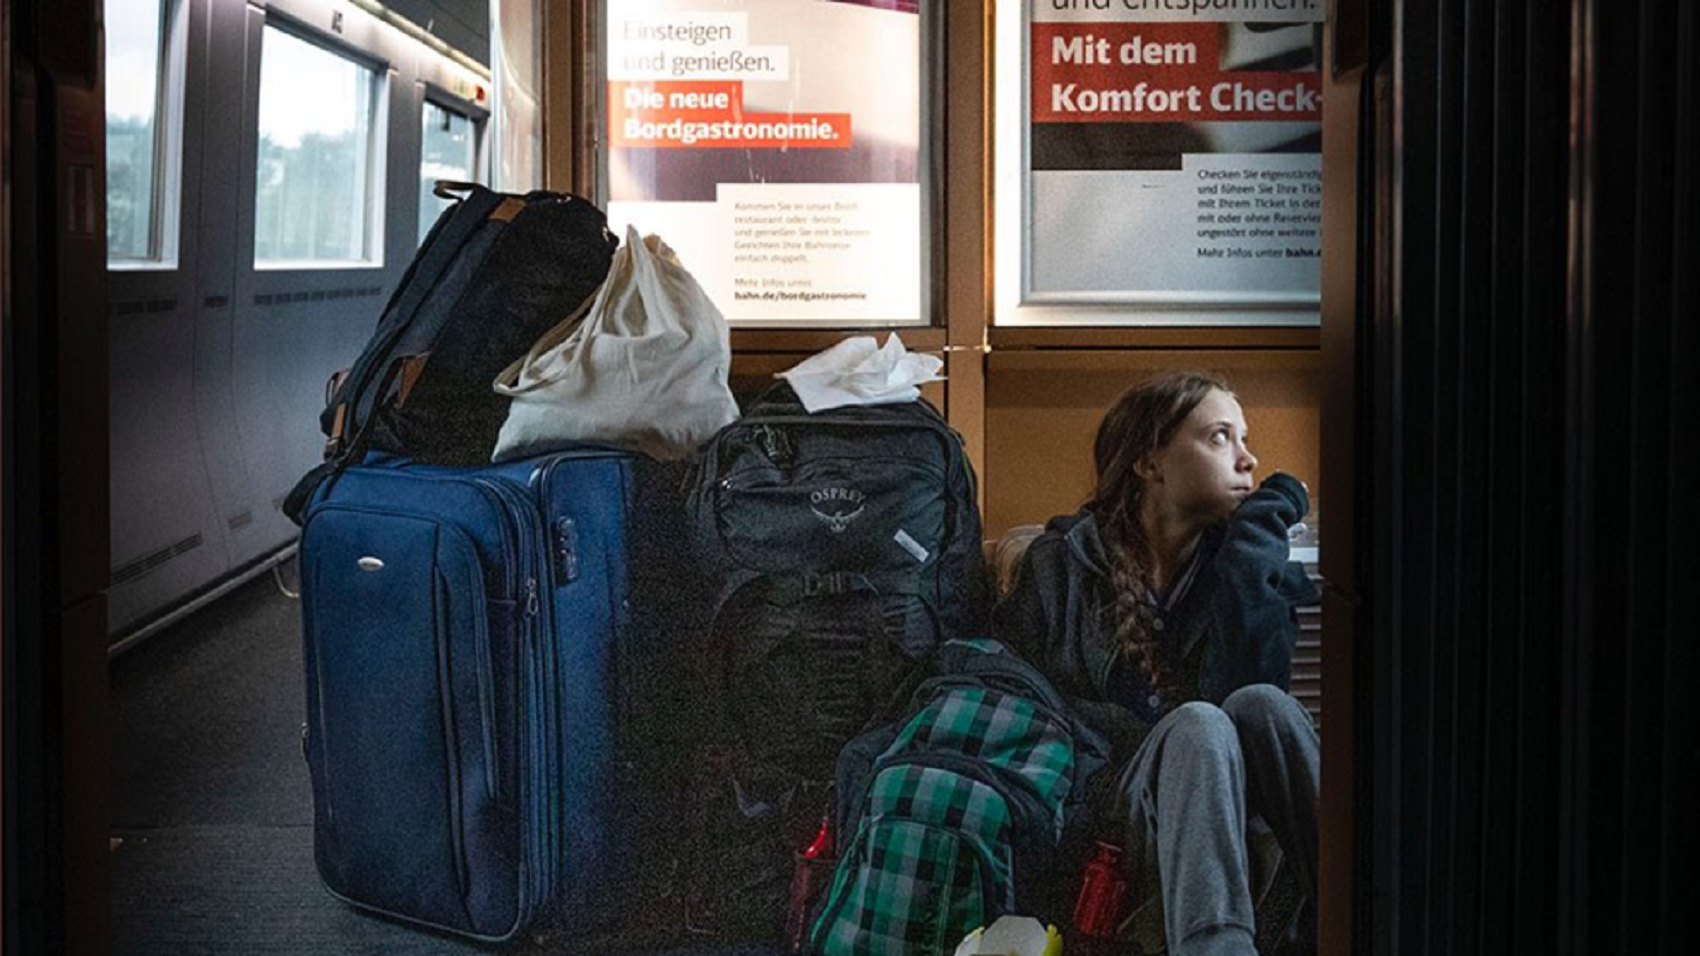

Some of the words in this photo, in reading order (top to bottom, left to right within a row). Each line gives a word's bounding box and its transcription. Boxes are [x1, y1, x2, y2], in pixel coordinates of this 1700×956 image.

[623, 20, 732, 46] Einsteigen
[1052, 35, 1111, 65] Mit
[1119, 36, 1197, 65] dem
[623, 53, 665, 71] und
[671, 50, 776, 76] genießen.
[624, 87, 664, 109] Die
[669, 91, 729, 109] neue
[1052, 82, 1201, 112] Komfort
[624, 118, 839, 143] Bordgastronomie.
[1198, 169, 1240, 180] Checken
[1243, 169, 1258, 179] Sie
[1198, 184, 1218, 194] und
[1221, 184, 1254, 194] führen
[1258, 184, 1273, 194] Sie
[1276, 184, 1298, 194] Ihre
[734, 202, 776, 211] Kommen
[778, 201, 792, 211] Sie
[794, 202, 804, 211] in
[1198, 199, 1216, 208] mit
[1219, 199, 1250, 208] Ihrem
[1255, 199, 1285, 208] Ticket
[1289, 199, 1300, 208] in
[734, 215, 783, 224] restaurant
[785, 214, 808, 224] oder
[1197, 213, 1215, 223] mit
[1217, 213, 1242, 223] oder
[1244, 213, 1270, 223] ohne
[734, 228, 753, 237] und
[755, 228, 797, 239] genießen
[799, 227, 813, 237] Sie
[814, 228, 830, 237] mit
[1197, 228, 1247, 239] ungestört
[1248, 228, 1275, 237] ohne
[1277, 229, 1316, 237] weitere
[734, 240, 781, 250] Gerichten
[782, 240, 802, 250] Ihre
[734, 253, 769, 263] einfach
[1198, 247, 1224, 258] Mehr
[1226, 247, 1253, 258] Infos
[1255, 248, 1283, 258] unter
[734, 278, 758, 287] Mehr
[762, 278, 786, 288] Infos
[787, 279, 812, 287] unter
[734, 290, 867, 302] bahn.de/bordgastronomie
[810, 487, 866, 504] OSPREY
